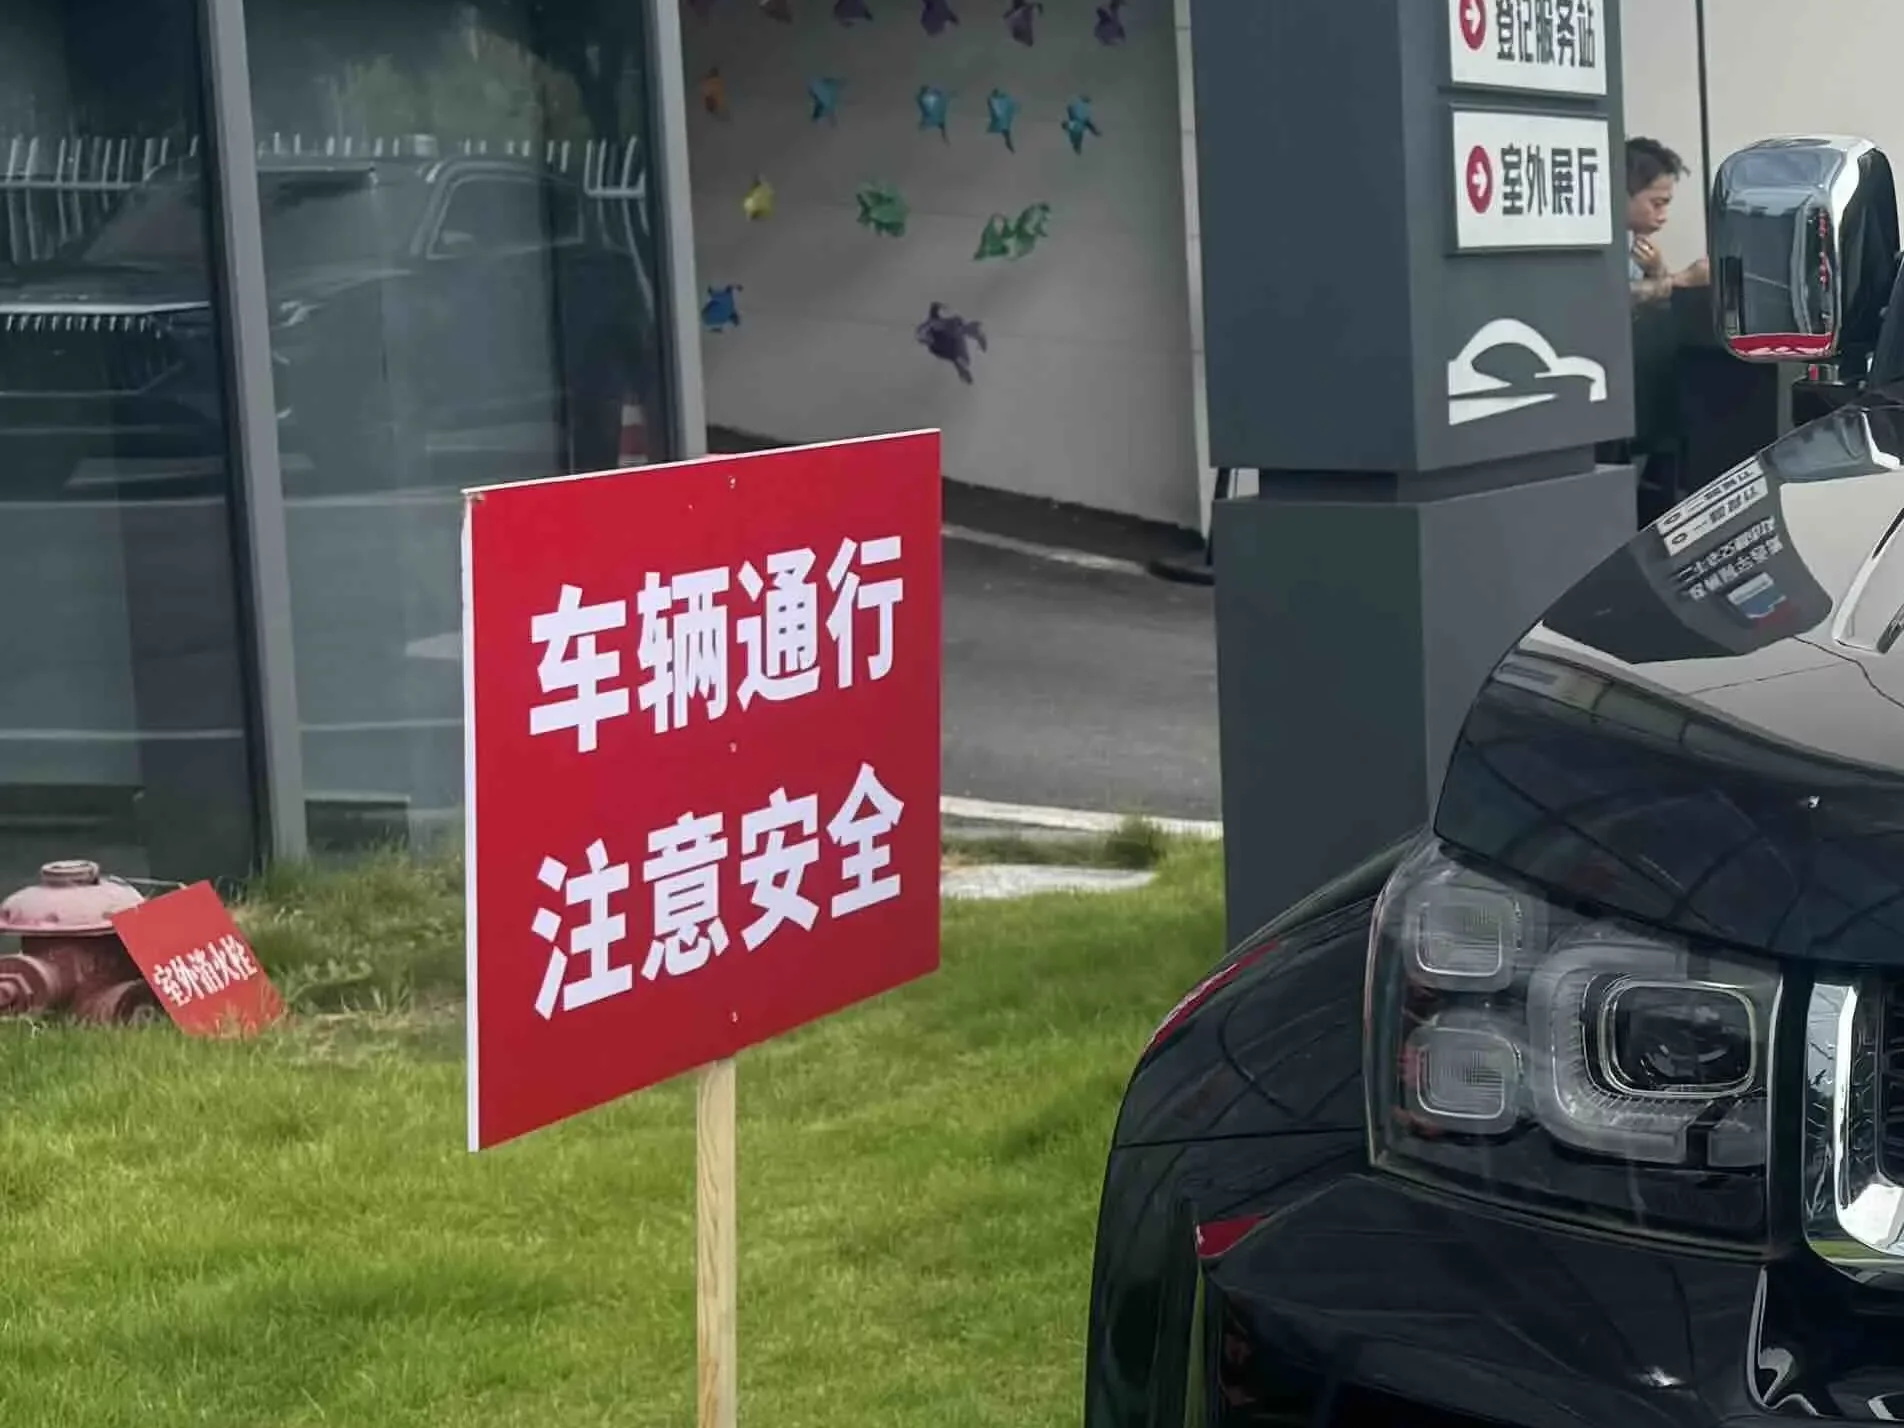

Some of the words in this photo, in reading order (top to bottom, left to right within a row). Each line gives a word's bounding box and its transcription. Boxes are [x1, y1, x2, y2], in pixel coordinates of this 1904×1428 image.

[1500, 143, 1599, 217] 室外展厅
[529, 535, 903, 753] 车辆通行
[531, 762, 905, 1020] 注意安全
[153, 934, 258, 1007] 室外消火栓
